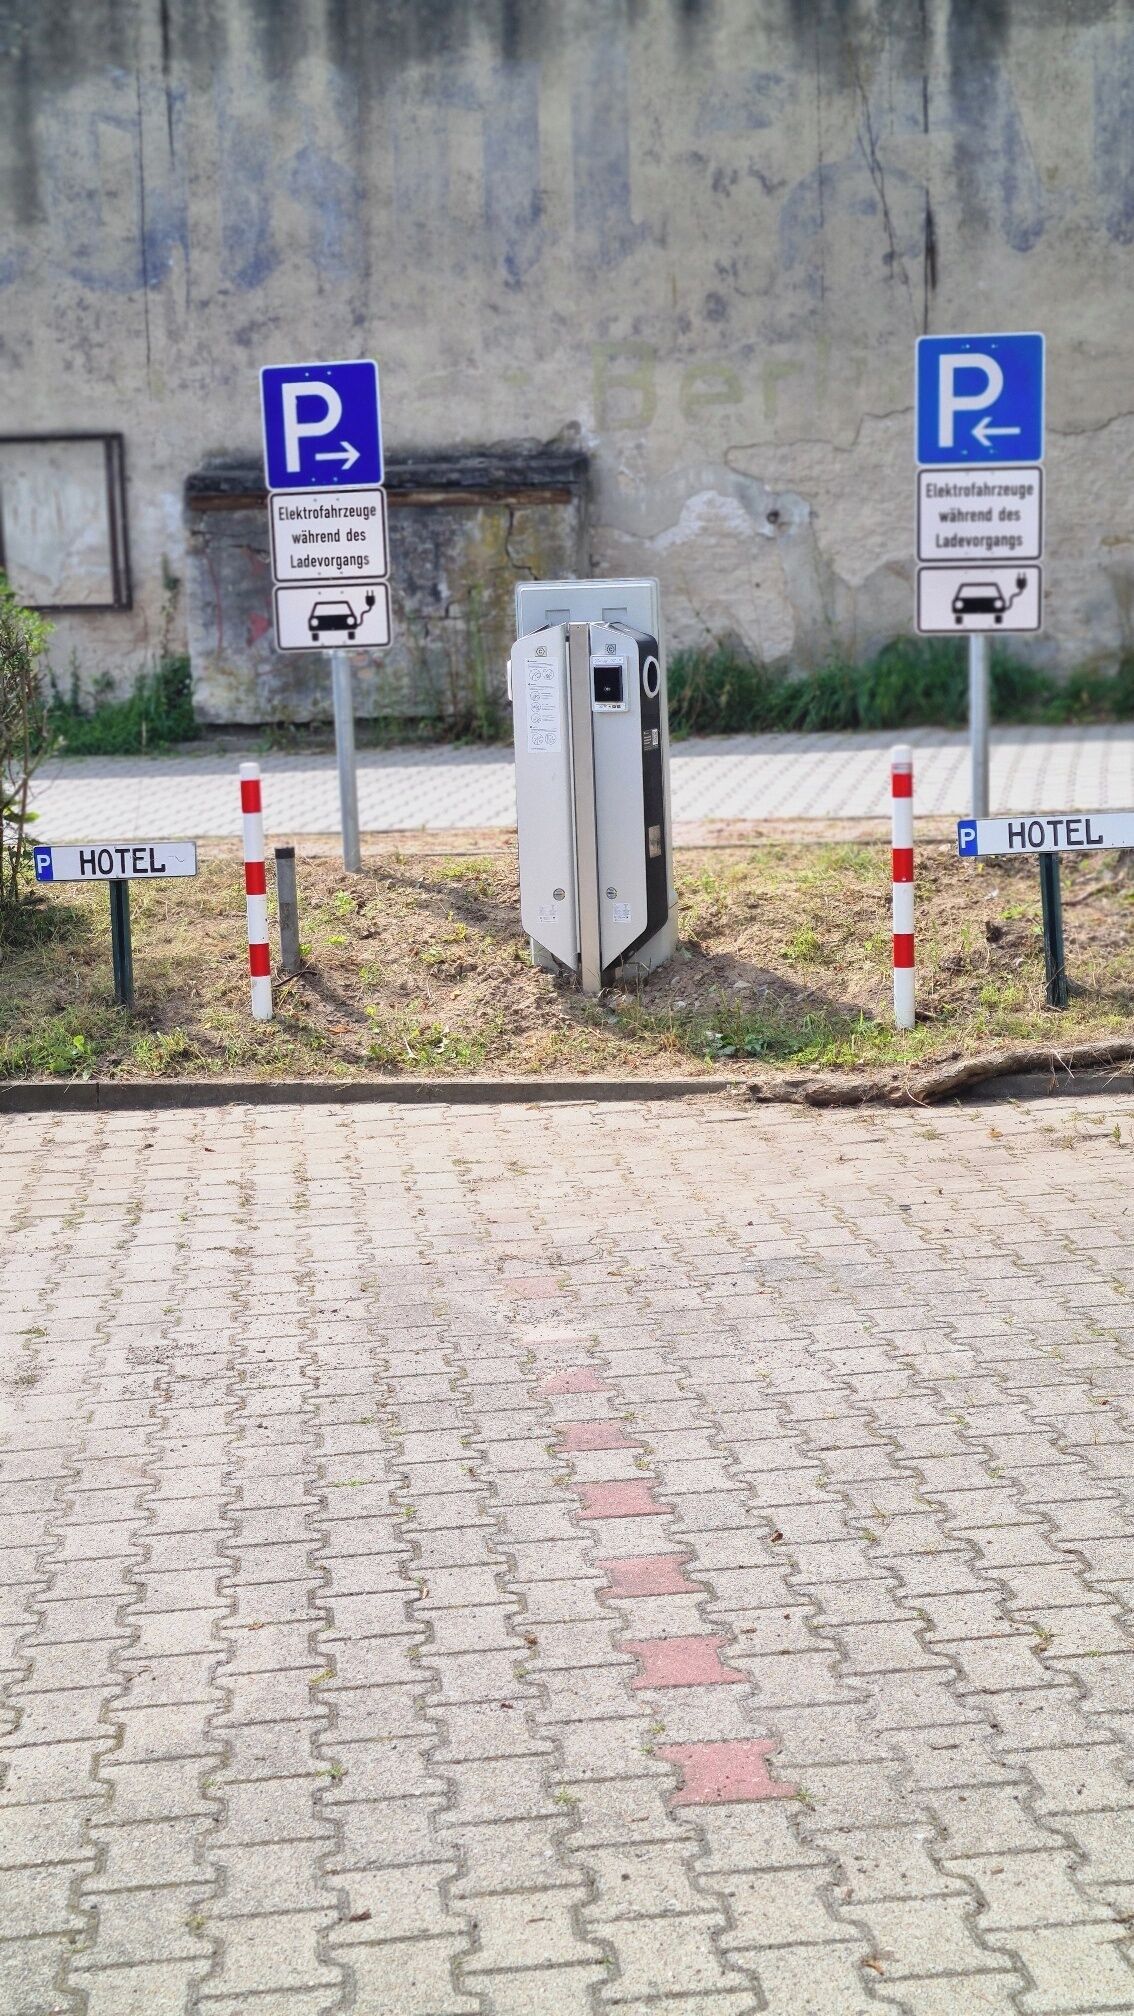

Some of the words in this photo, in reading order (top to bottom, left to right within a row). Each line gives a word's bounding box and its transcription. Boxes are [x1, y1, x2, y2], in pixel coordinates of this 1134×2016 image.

[937, 353, 1004, 448] P
[281, 381, 343, 473] P
[926, 482, 1034, 500] Elektrofahrzeuge
[278, 504, 377, 521] Elektrofahrzeuge
[939, 507, 993, 524] während
[998, 506, 1021, 522] des
[291, 529, 341, 545] während
[346, 528, 367, 543] des
[936, 533, 1023, 550] Ladevorgangs
[290, 554, 370, 571] Ladevorgangs
[960, 828, 976, 849] P
[1007, 818, 1104, 849] HOTEL
[36, 854, 51, 874] P
[79, 847, 166, 876] HOTEL
